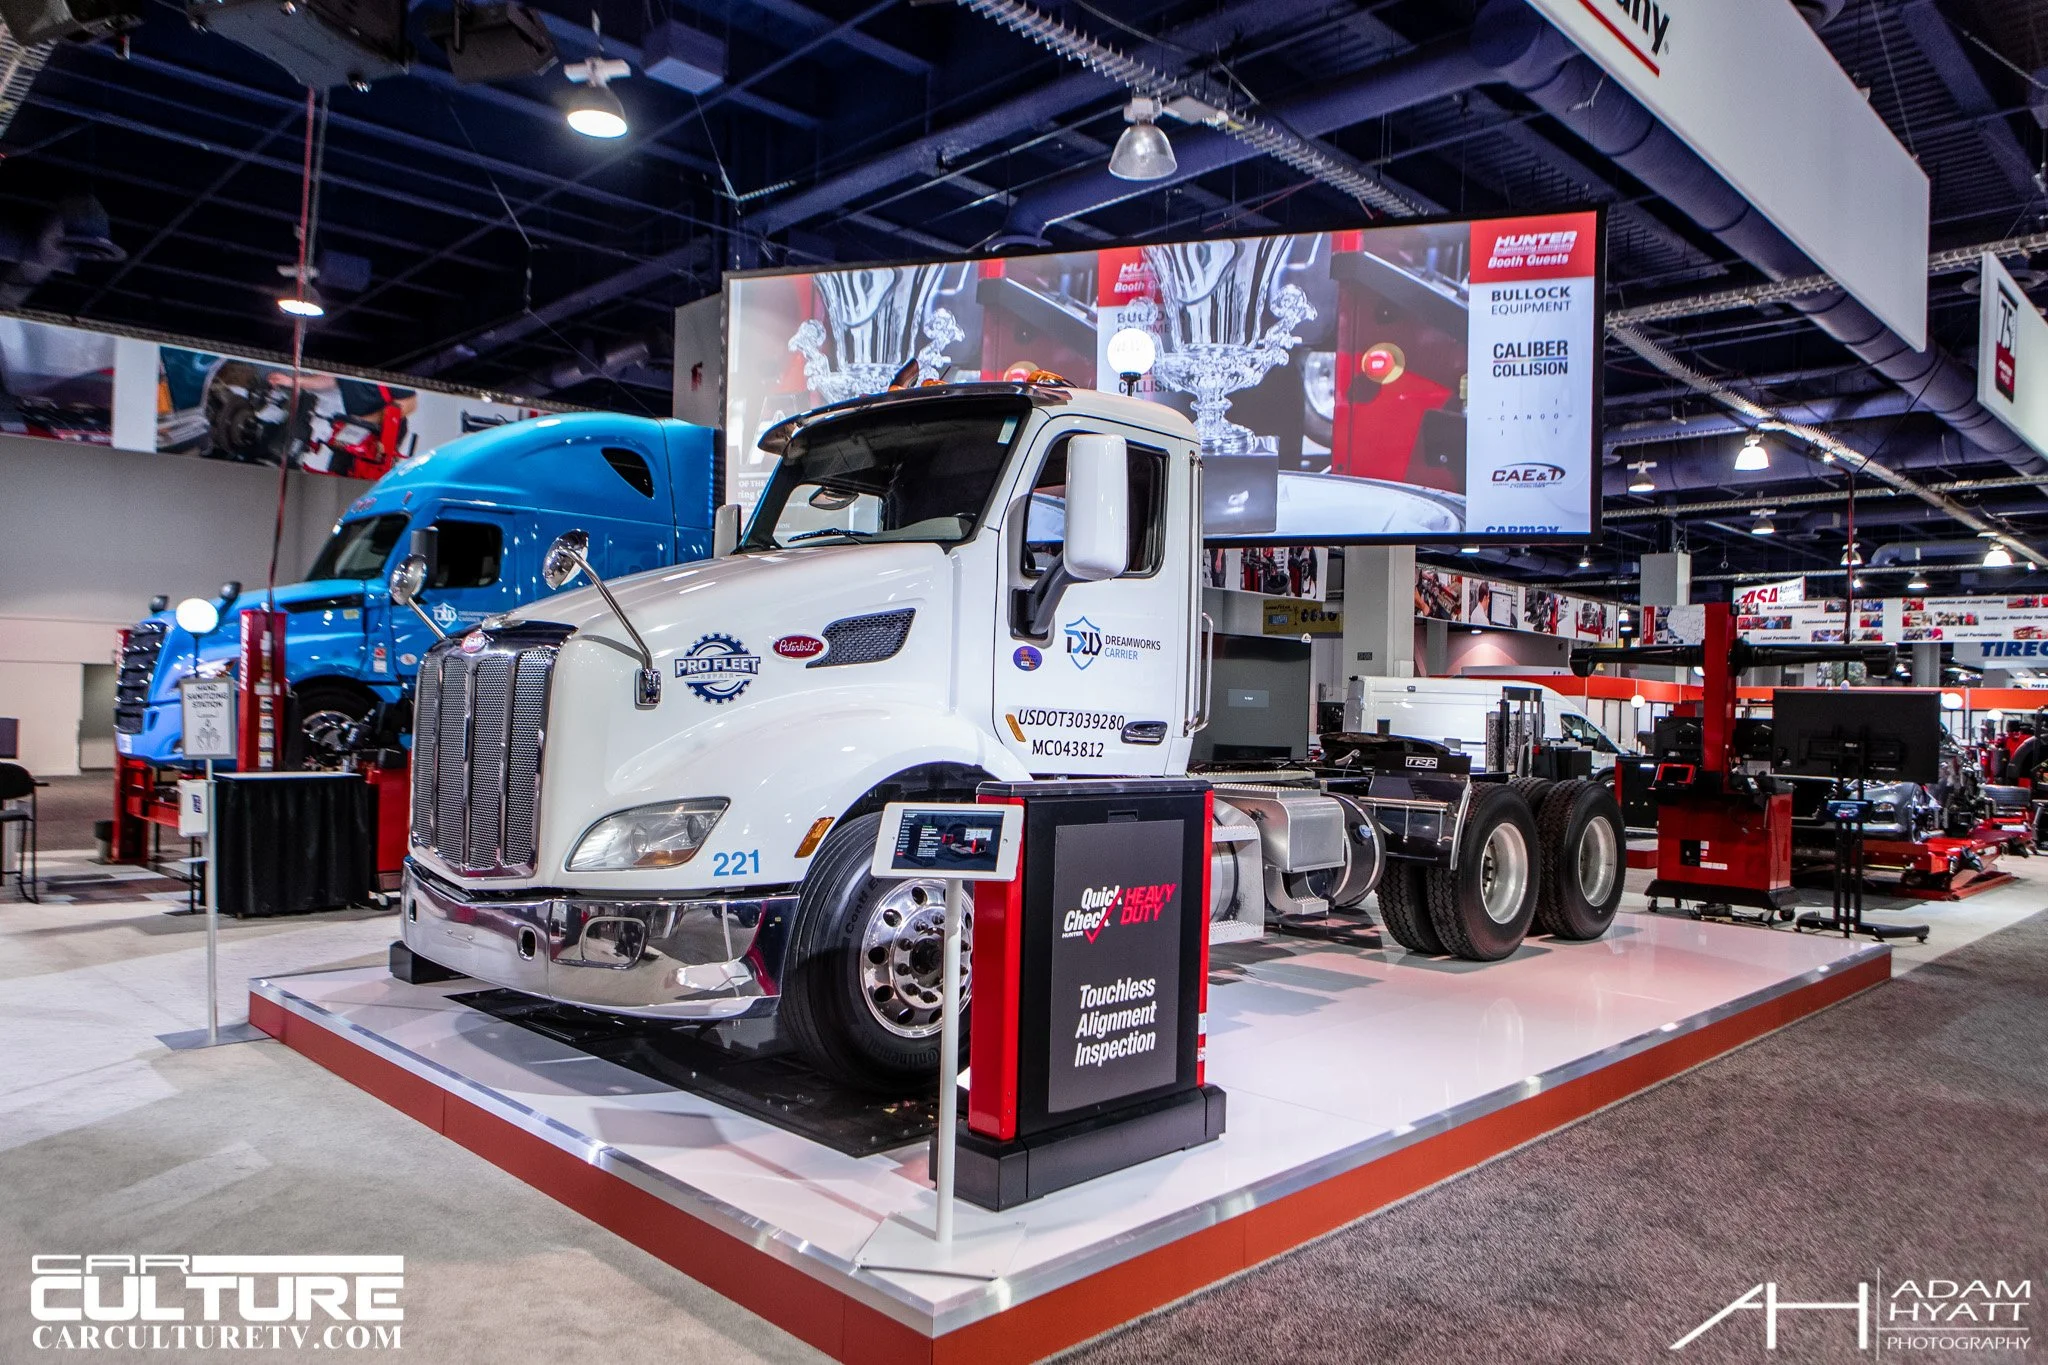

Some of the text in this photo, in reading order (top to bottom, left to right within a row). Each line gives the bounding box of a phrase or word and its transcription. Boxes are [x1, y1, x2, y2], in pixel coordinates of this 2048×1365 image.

[1495, 231, 1577, 248] HUNTER
[1488, 254, 1569, 269] Booth Guests
[1114, 281, 1145, 293] Booth
[1491, 286, 1571, 302] BULLOCK
[1491, 300, 1572, 316] EQUIPMENT
[1493, 340, 1568, 359] CALIBER
[1493, 362, 1568, 377] COLLISION
[1491, 468, 1562, 482] CAE&T
[779, 640, 819, 652] Peterbilt
[1105, 634, 1161, 651] DREAMWORKS
[1104, 647, 1138, 660] CARRIER
[676, 658, 759, 675] PRO FLEET
[1018, 709, 1125, 731] USDOT3039280
[1032, 739, 1104, 758] MC043812
[1408, 758, 1437, 768] TRP
[713, 849, 759, 876] 221
[1081, 885, 1122, 910] Quick
[1124, 883, 1177, 903] HEAVY
[1063, 907, 1110, 932] Check
[1120, 902, 1164, 925] DUTY
[1062, 930, 1083, 938] HUNTER
[1080, 977, 1156, 1009] Touchless
[1075, 1001, 1157, 1039] Alignment
[1074, 1031, 1156, 1067] Inspection
